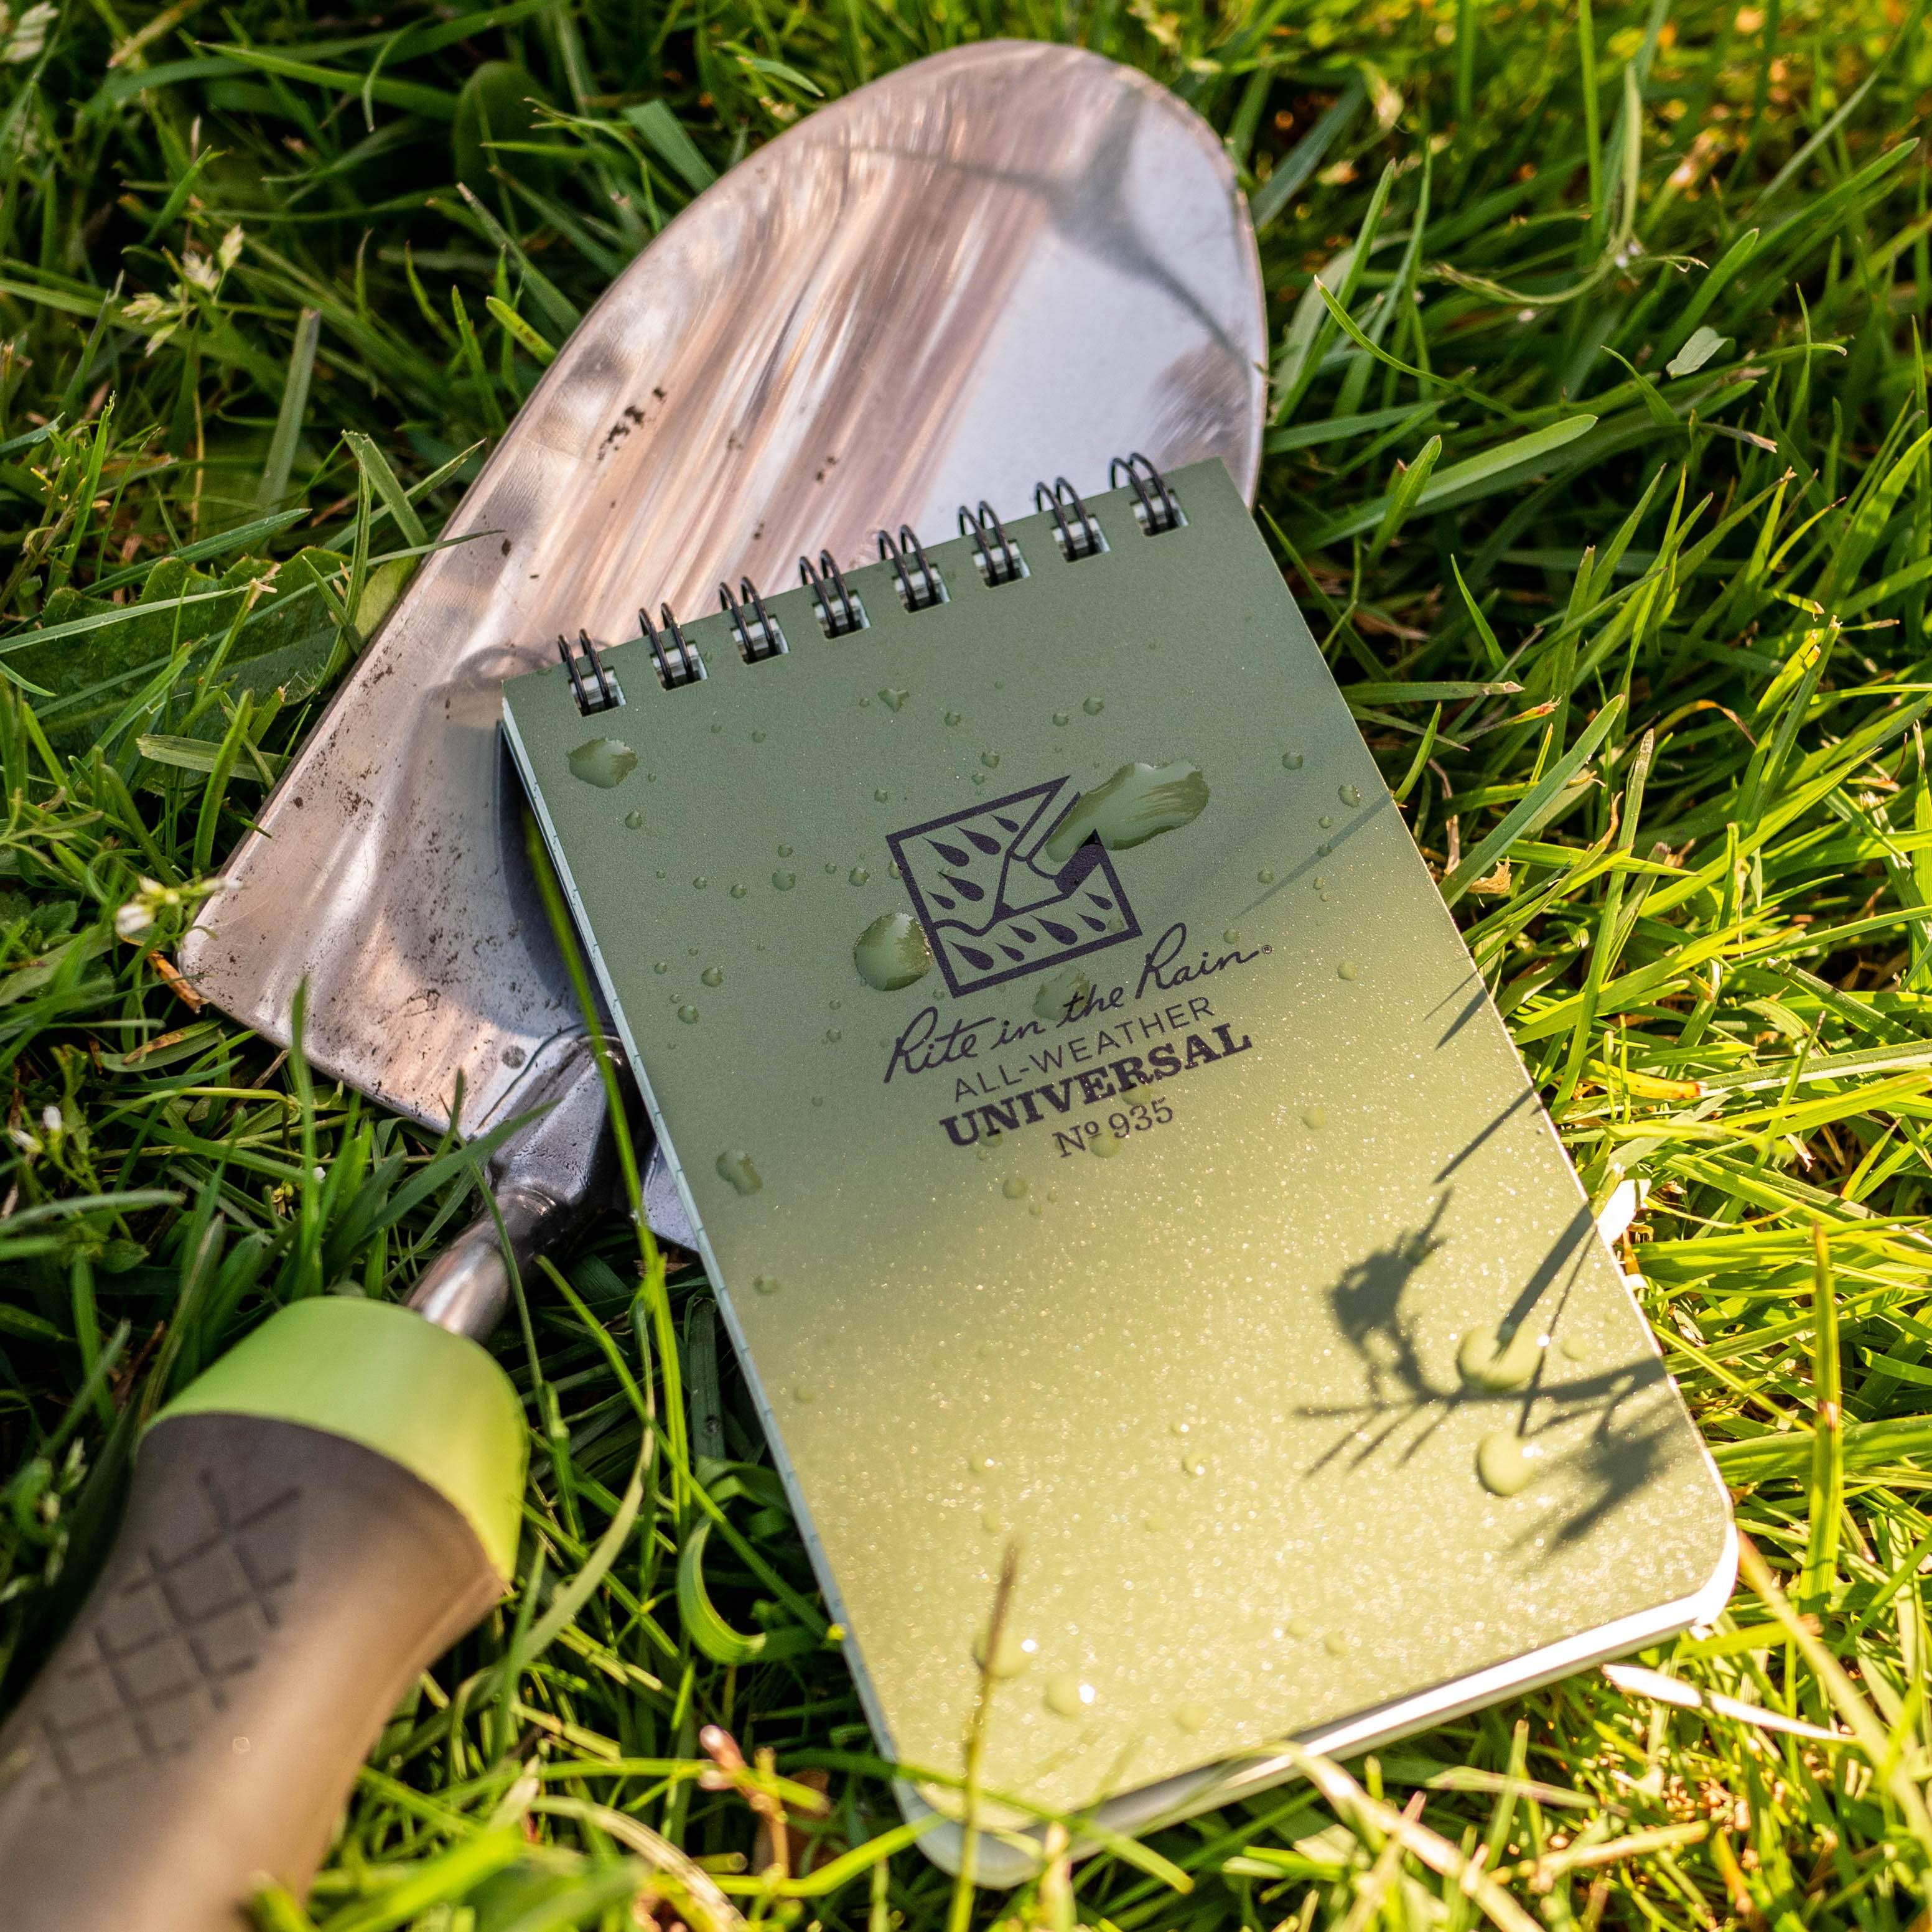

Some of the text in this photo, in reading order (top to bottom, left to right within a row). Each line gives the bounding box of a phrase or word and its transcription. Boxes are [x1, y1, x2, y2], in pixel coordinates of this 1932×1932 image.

[884, 1006, 996, 1083] Rite
[991, 1019, 1046, 1050] in
[1056, 984, 1124, 1028] the
[940, 1022, 1253, 1146] UNIVERSAL
[954, 997, 1215, 1103] ALL-WEATHER
[1108, 1097, 1174, 1139] 935
